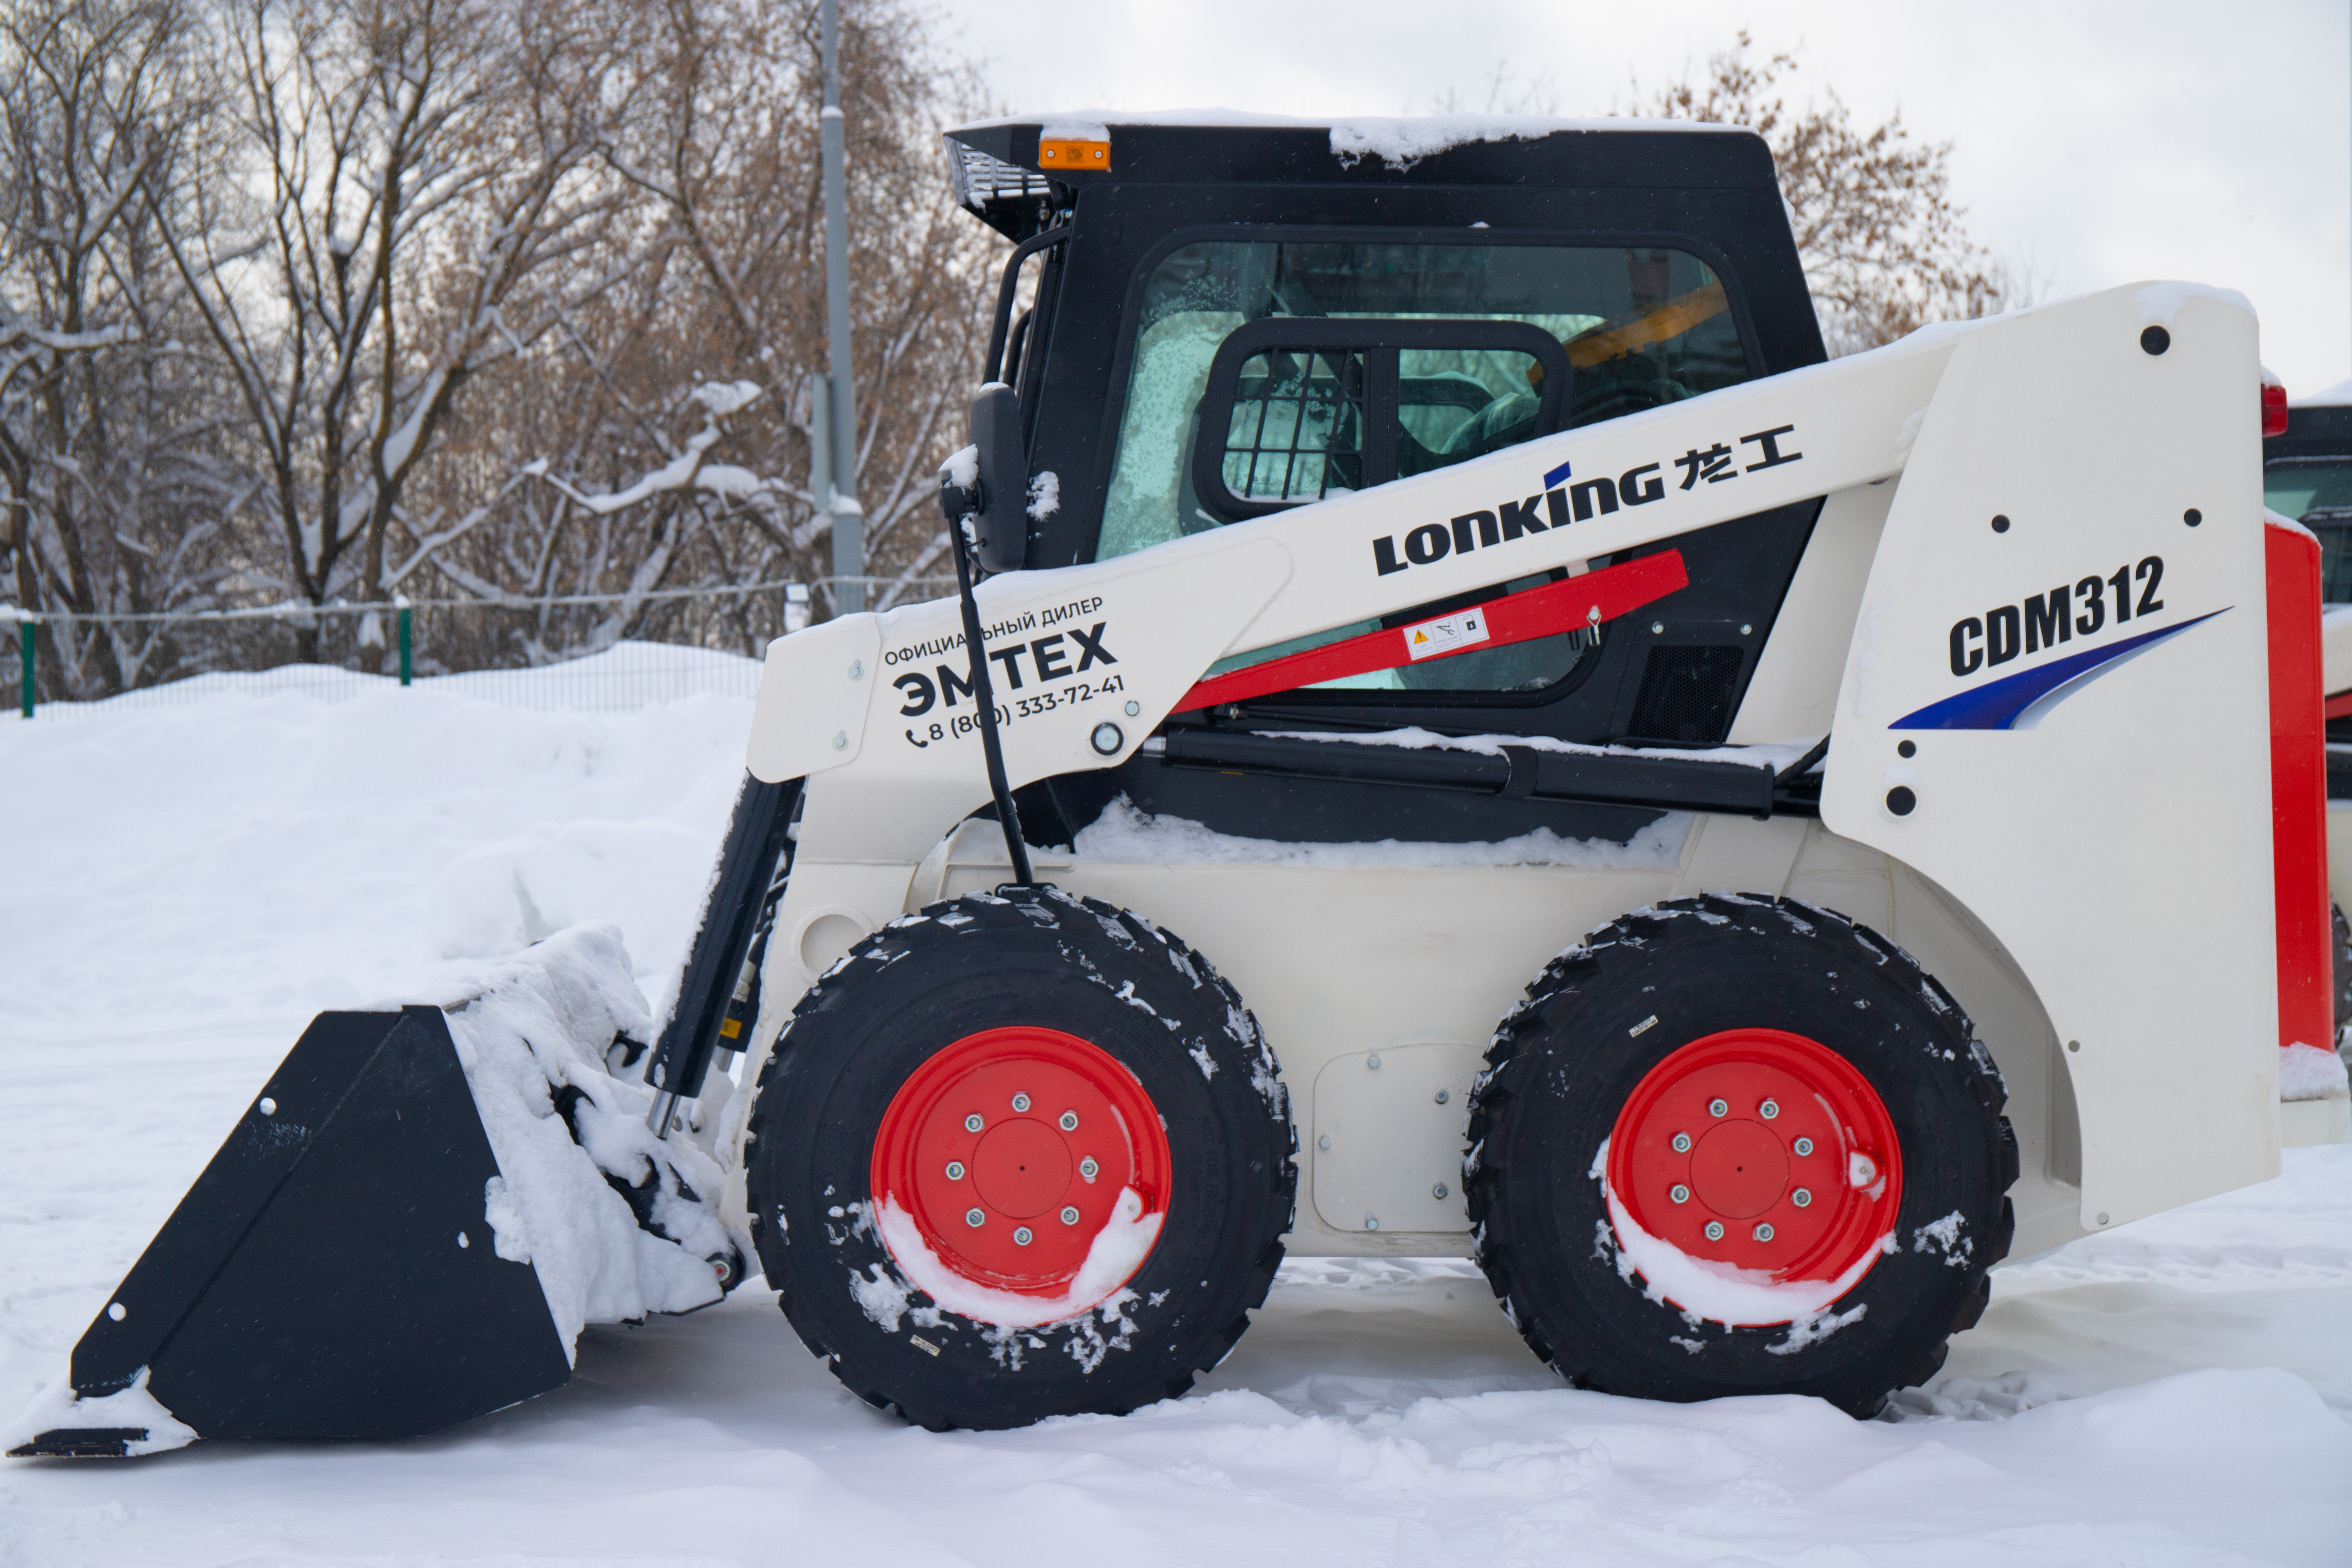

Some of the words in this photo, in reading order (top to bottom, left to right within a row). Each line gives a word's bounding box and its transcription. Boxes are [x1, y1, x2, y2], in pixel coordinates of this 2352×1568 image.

[885, 611, 1036, 665] ОФИЦИАЬНЫЙ
[1042, 597, 1102, 628] ДИЛЕР
[1950, 556, 2164, 677] CDM312
[929, 723, 943, 740] 8
[1016, 675, 1124, 717] 333-72-41
